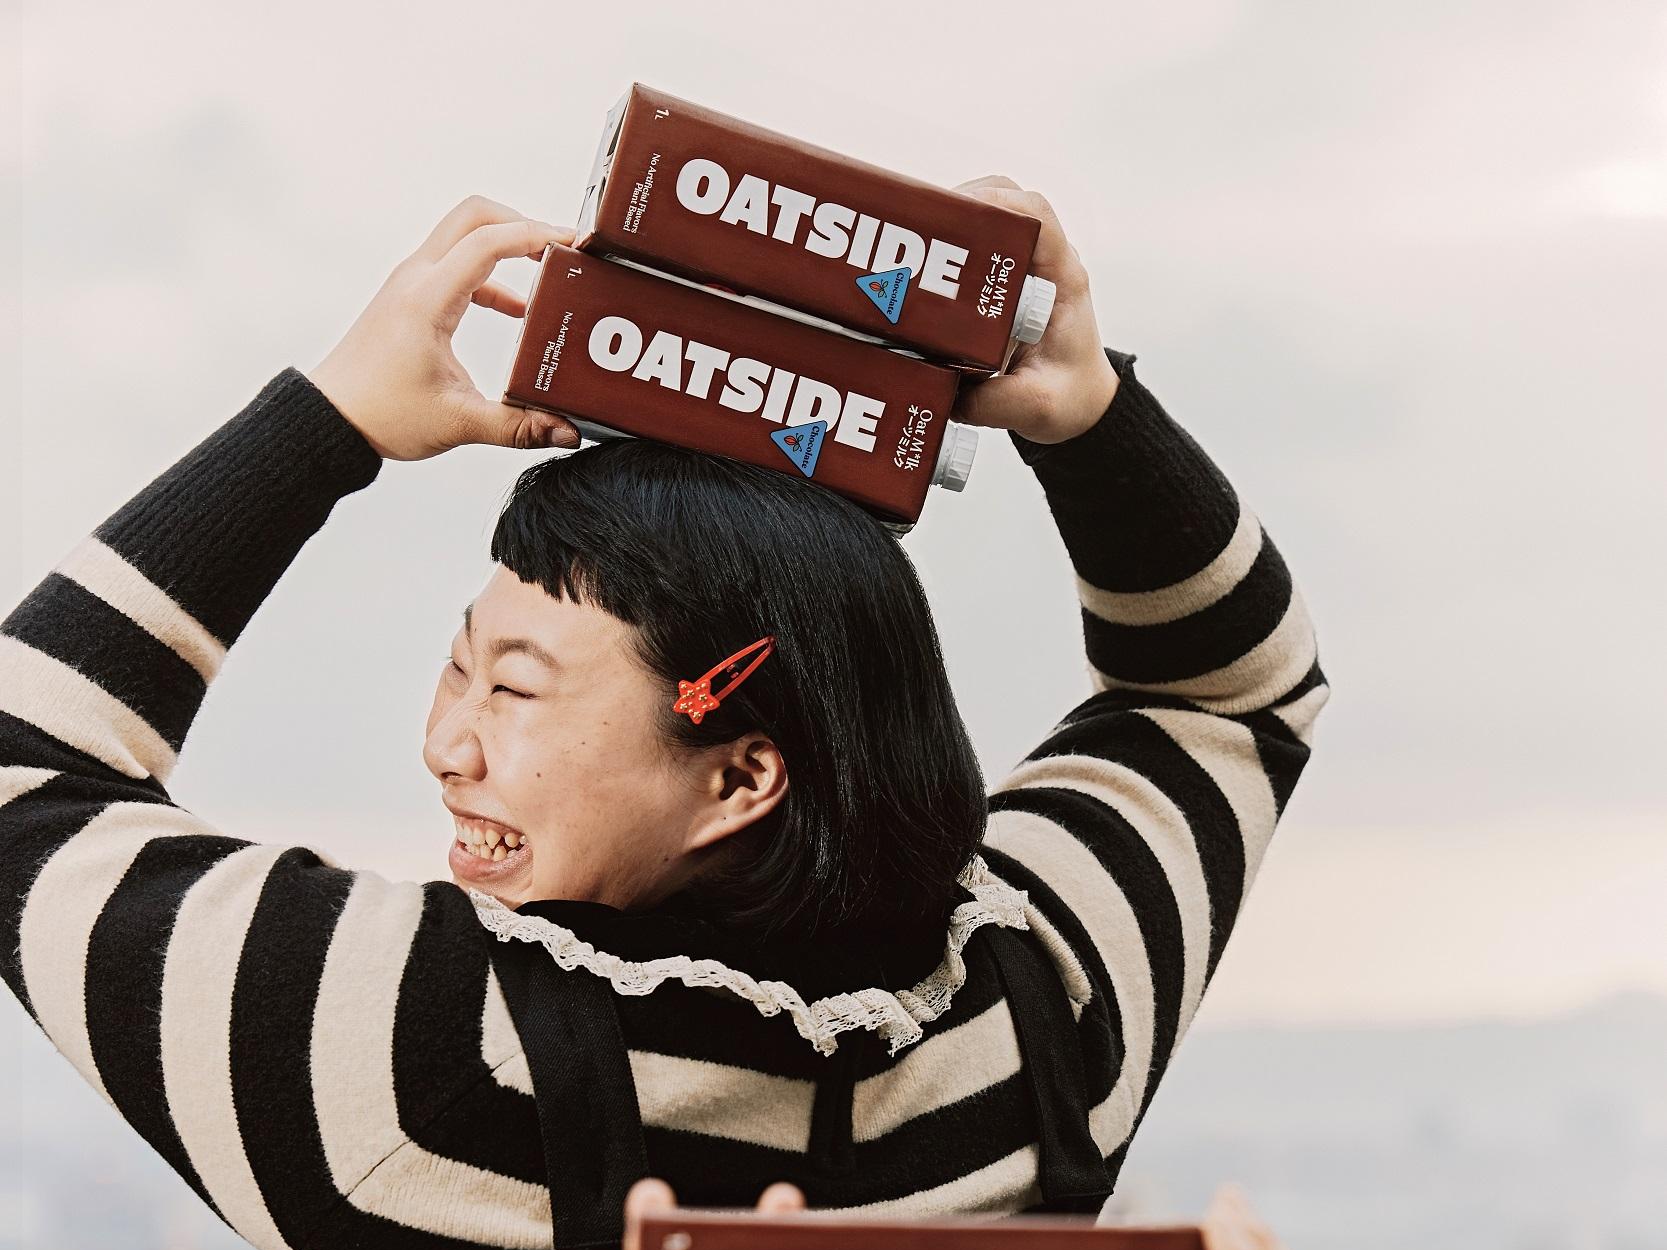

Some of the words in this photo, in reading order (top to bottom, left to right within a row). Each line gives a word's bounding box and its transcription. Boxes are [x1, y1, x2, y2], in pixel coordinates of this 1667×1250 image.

[650, 152, 661, 166] No
[630, 182, 643, 206] Plant
[639, 165, 657, 203] Artificial
[622, 206, 637, 232] Based
[630, 202, 647, 234] Flavors
[676, 158, 970, 301] OATSIDE
[997, 257, 1016, 285] Oat
[886, 272, 905, 316] Chocolate
[562, 311, 574, 324] No
[543, 340, 556, 363] Plant
[551, 324, 569, 361] Artificial
[534, 364, 549, 390] Based
[542, 360, 559, 392] Flavors
[588, 316, 887, 454] OATSIDE
[914, 409, 933, 435] Oat
[801, 425, 820, 469] Chocolate
